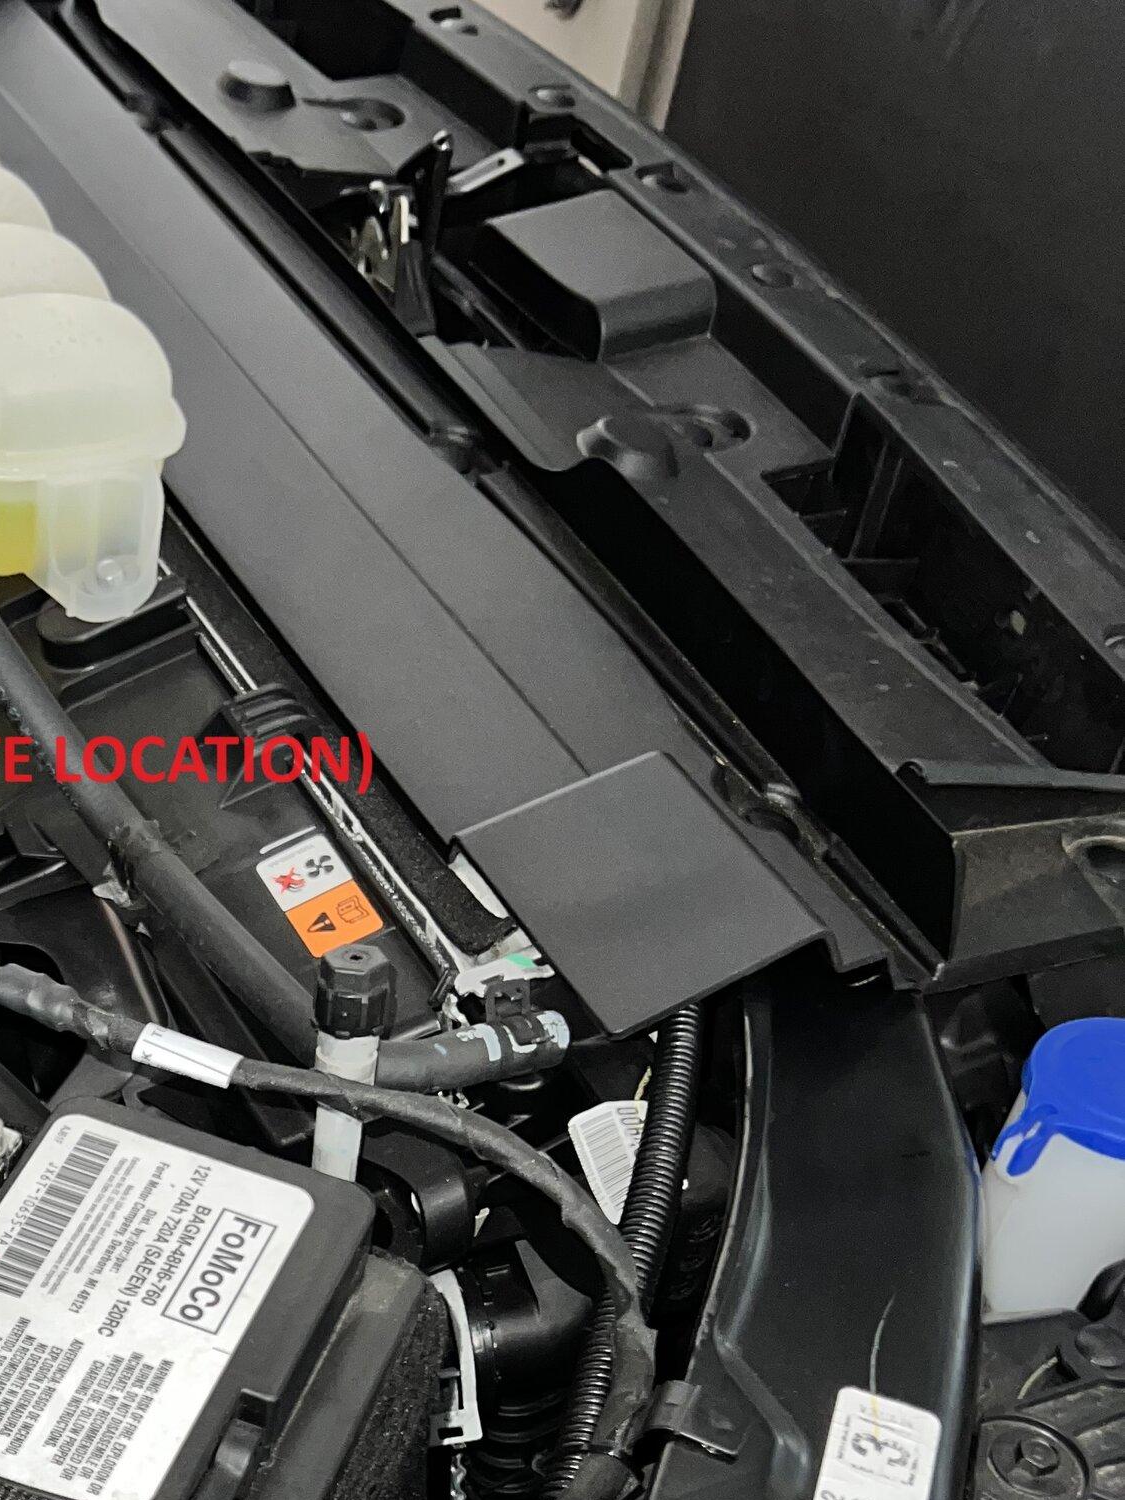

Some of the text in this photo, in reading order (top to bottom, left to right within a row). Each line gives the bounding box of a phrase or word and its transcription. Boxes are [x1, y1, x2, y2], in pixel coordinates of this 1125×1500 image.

[149, 1161, 170, 1179] Ford
[136, 1178, 159, 1201] Motor
[96, 1163, 212, 1338] 12V 70Ah 720A (SAE/EN) 120RC
[139, 1204, 212, 1308] BAGM-48H6-760
[82, 1276, 99, 1289] MI
[176, 1215, 263, 1326] FoMoCo
[67, 1288, 92, 1314] 48121
